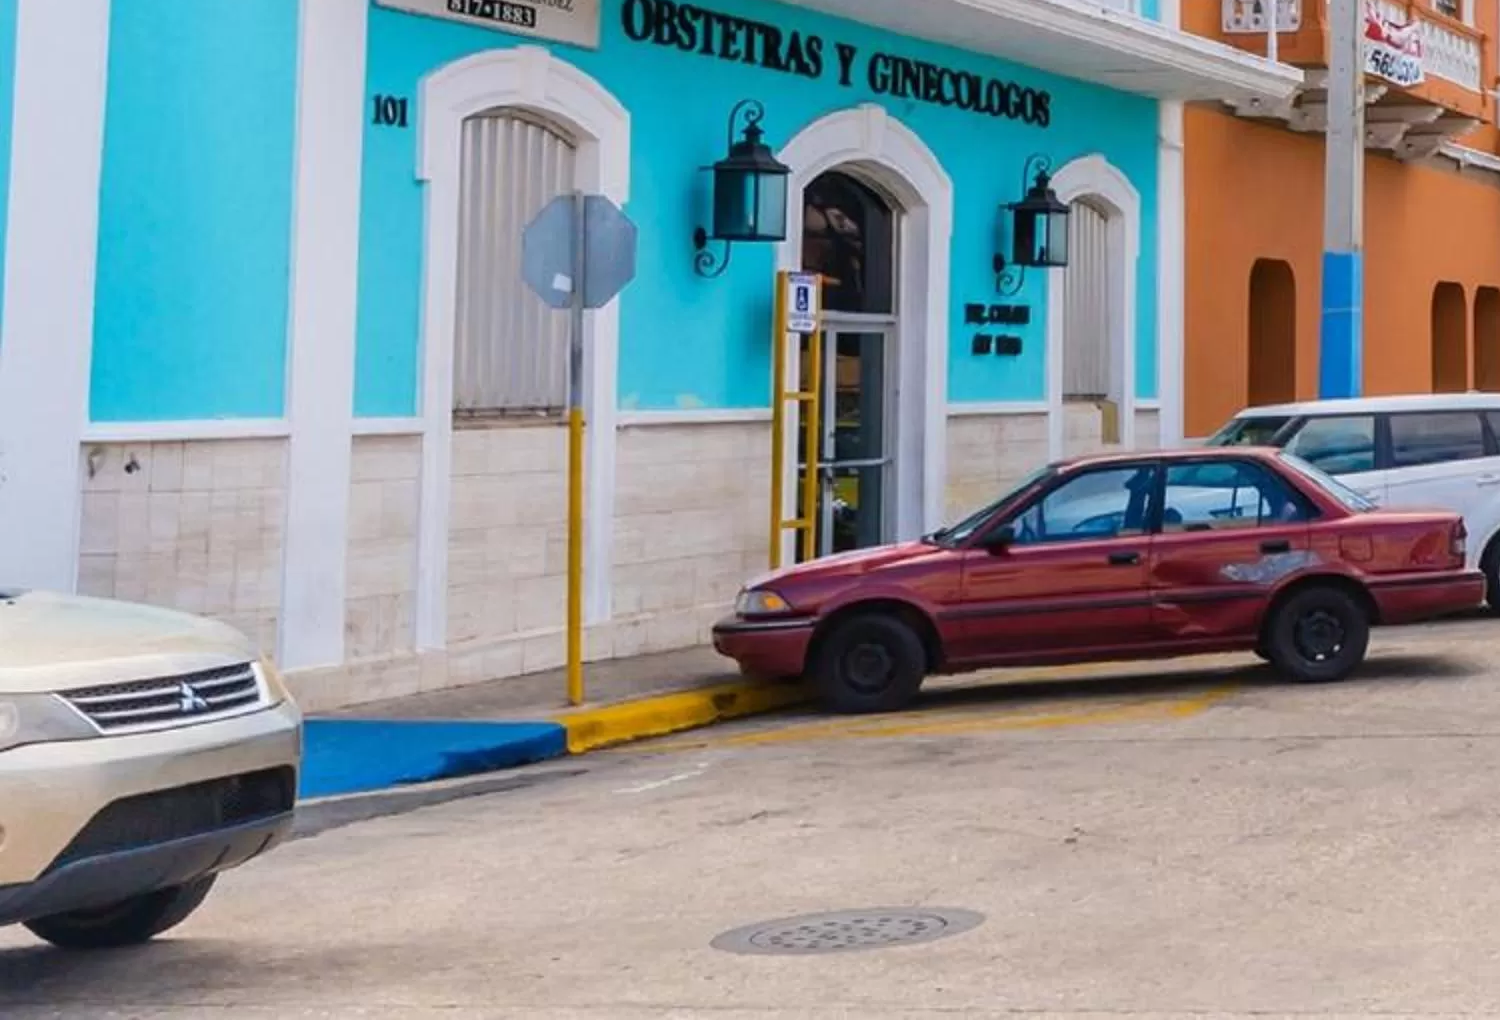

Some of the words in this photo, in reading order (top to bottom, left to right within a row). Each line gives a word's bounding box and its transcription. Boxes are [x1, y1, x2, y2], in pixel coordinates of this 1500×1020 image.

[372, 93, 408, 128] 101
[835, 43, 857, 87] Y
[868, 52, 1050, 128] GINECOLOGOS
